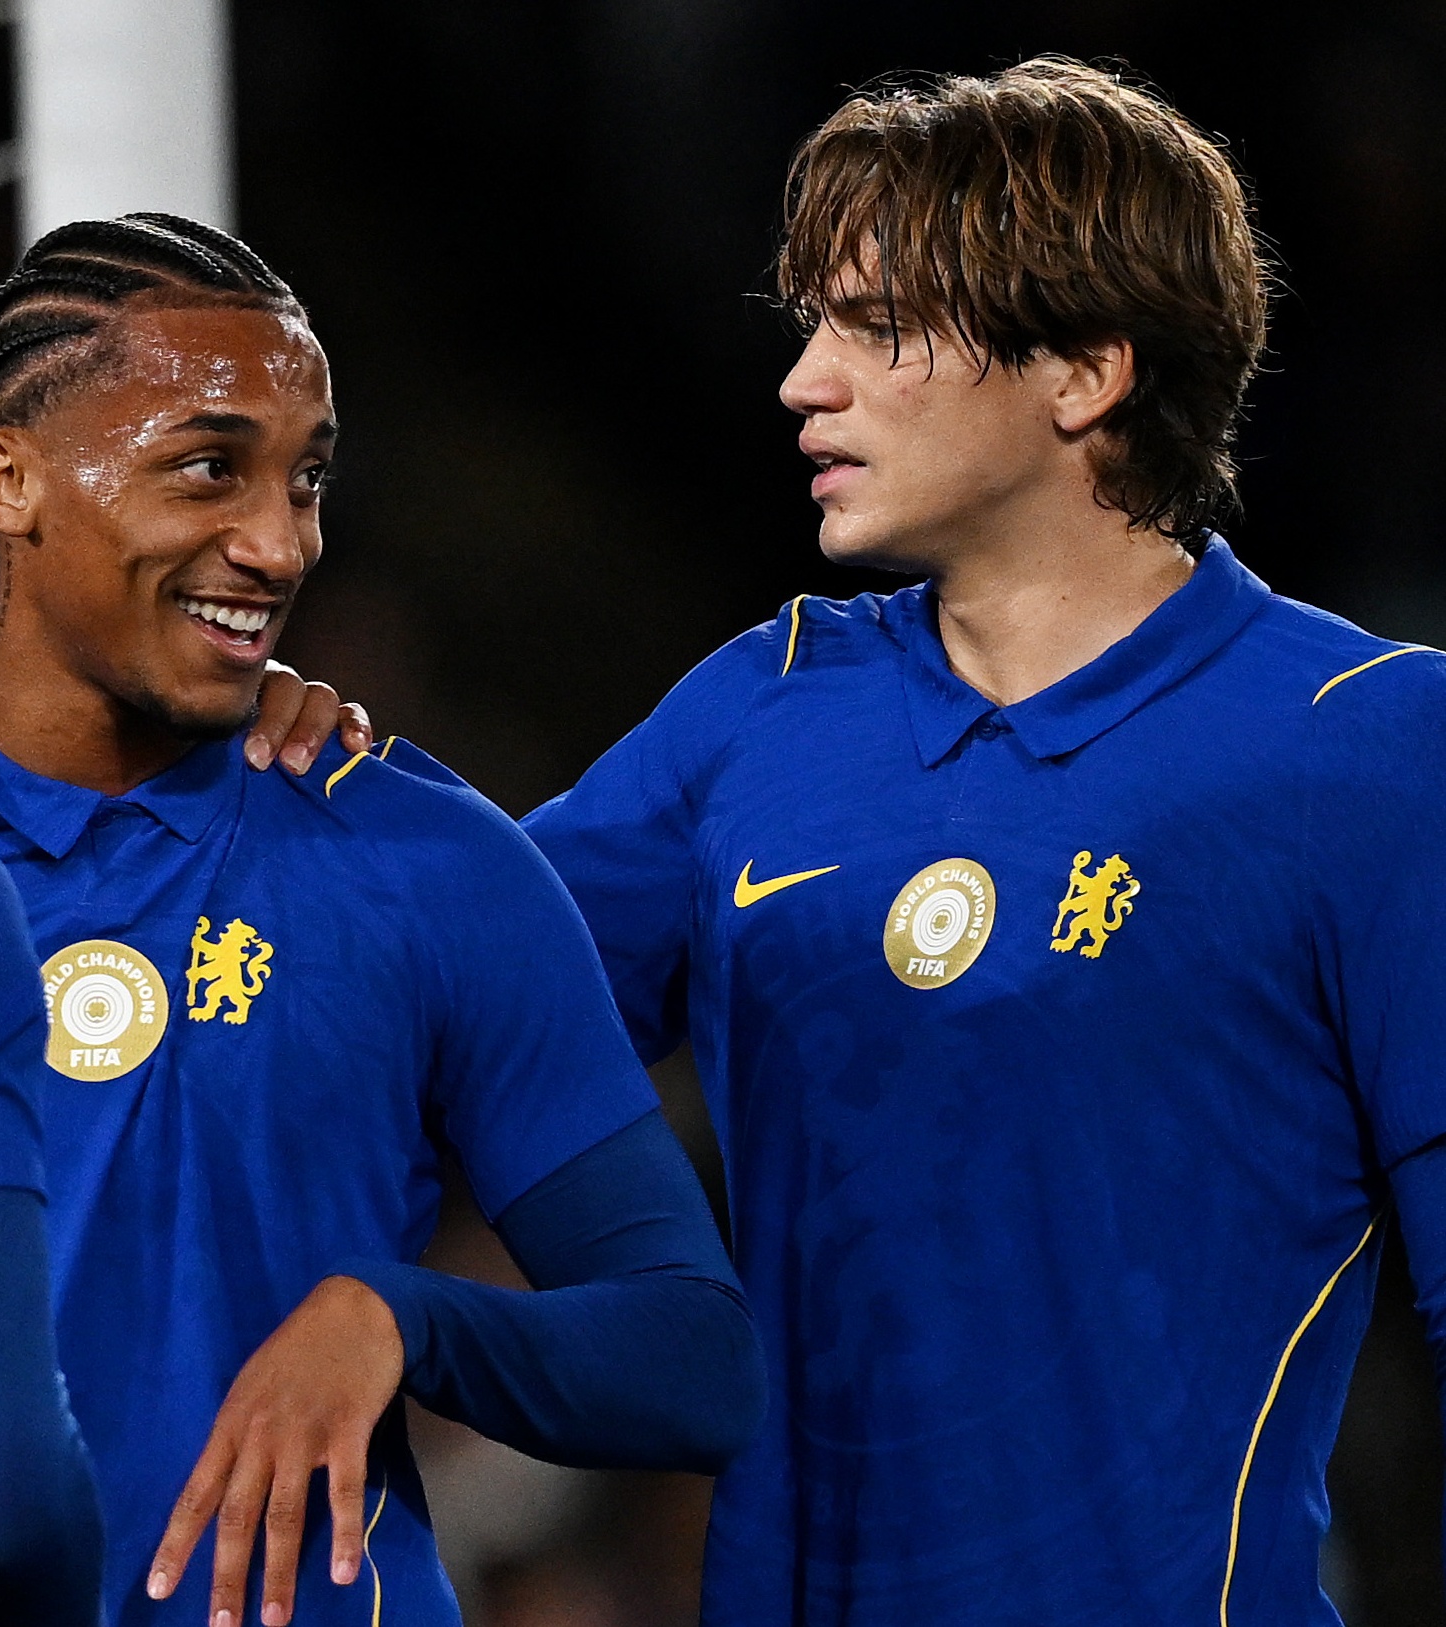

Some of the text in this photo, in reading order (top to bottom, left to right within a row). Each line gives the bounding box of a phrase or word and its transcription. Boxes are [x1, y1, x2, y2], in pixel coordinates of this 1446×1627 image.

[894, 869, 986, 940] WORLD CHAMPIONS
[78, 952, 155, 1025] CHAMPIONS
[906, 957, 945, 977] FIFA
[70, 1048, 121, 1067] FIFA
